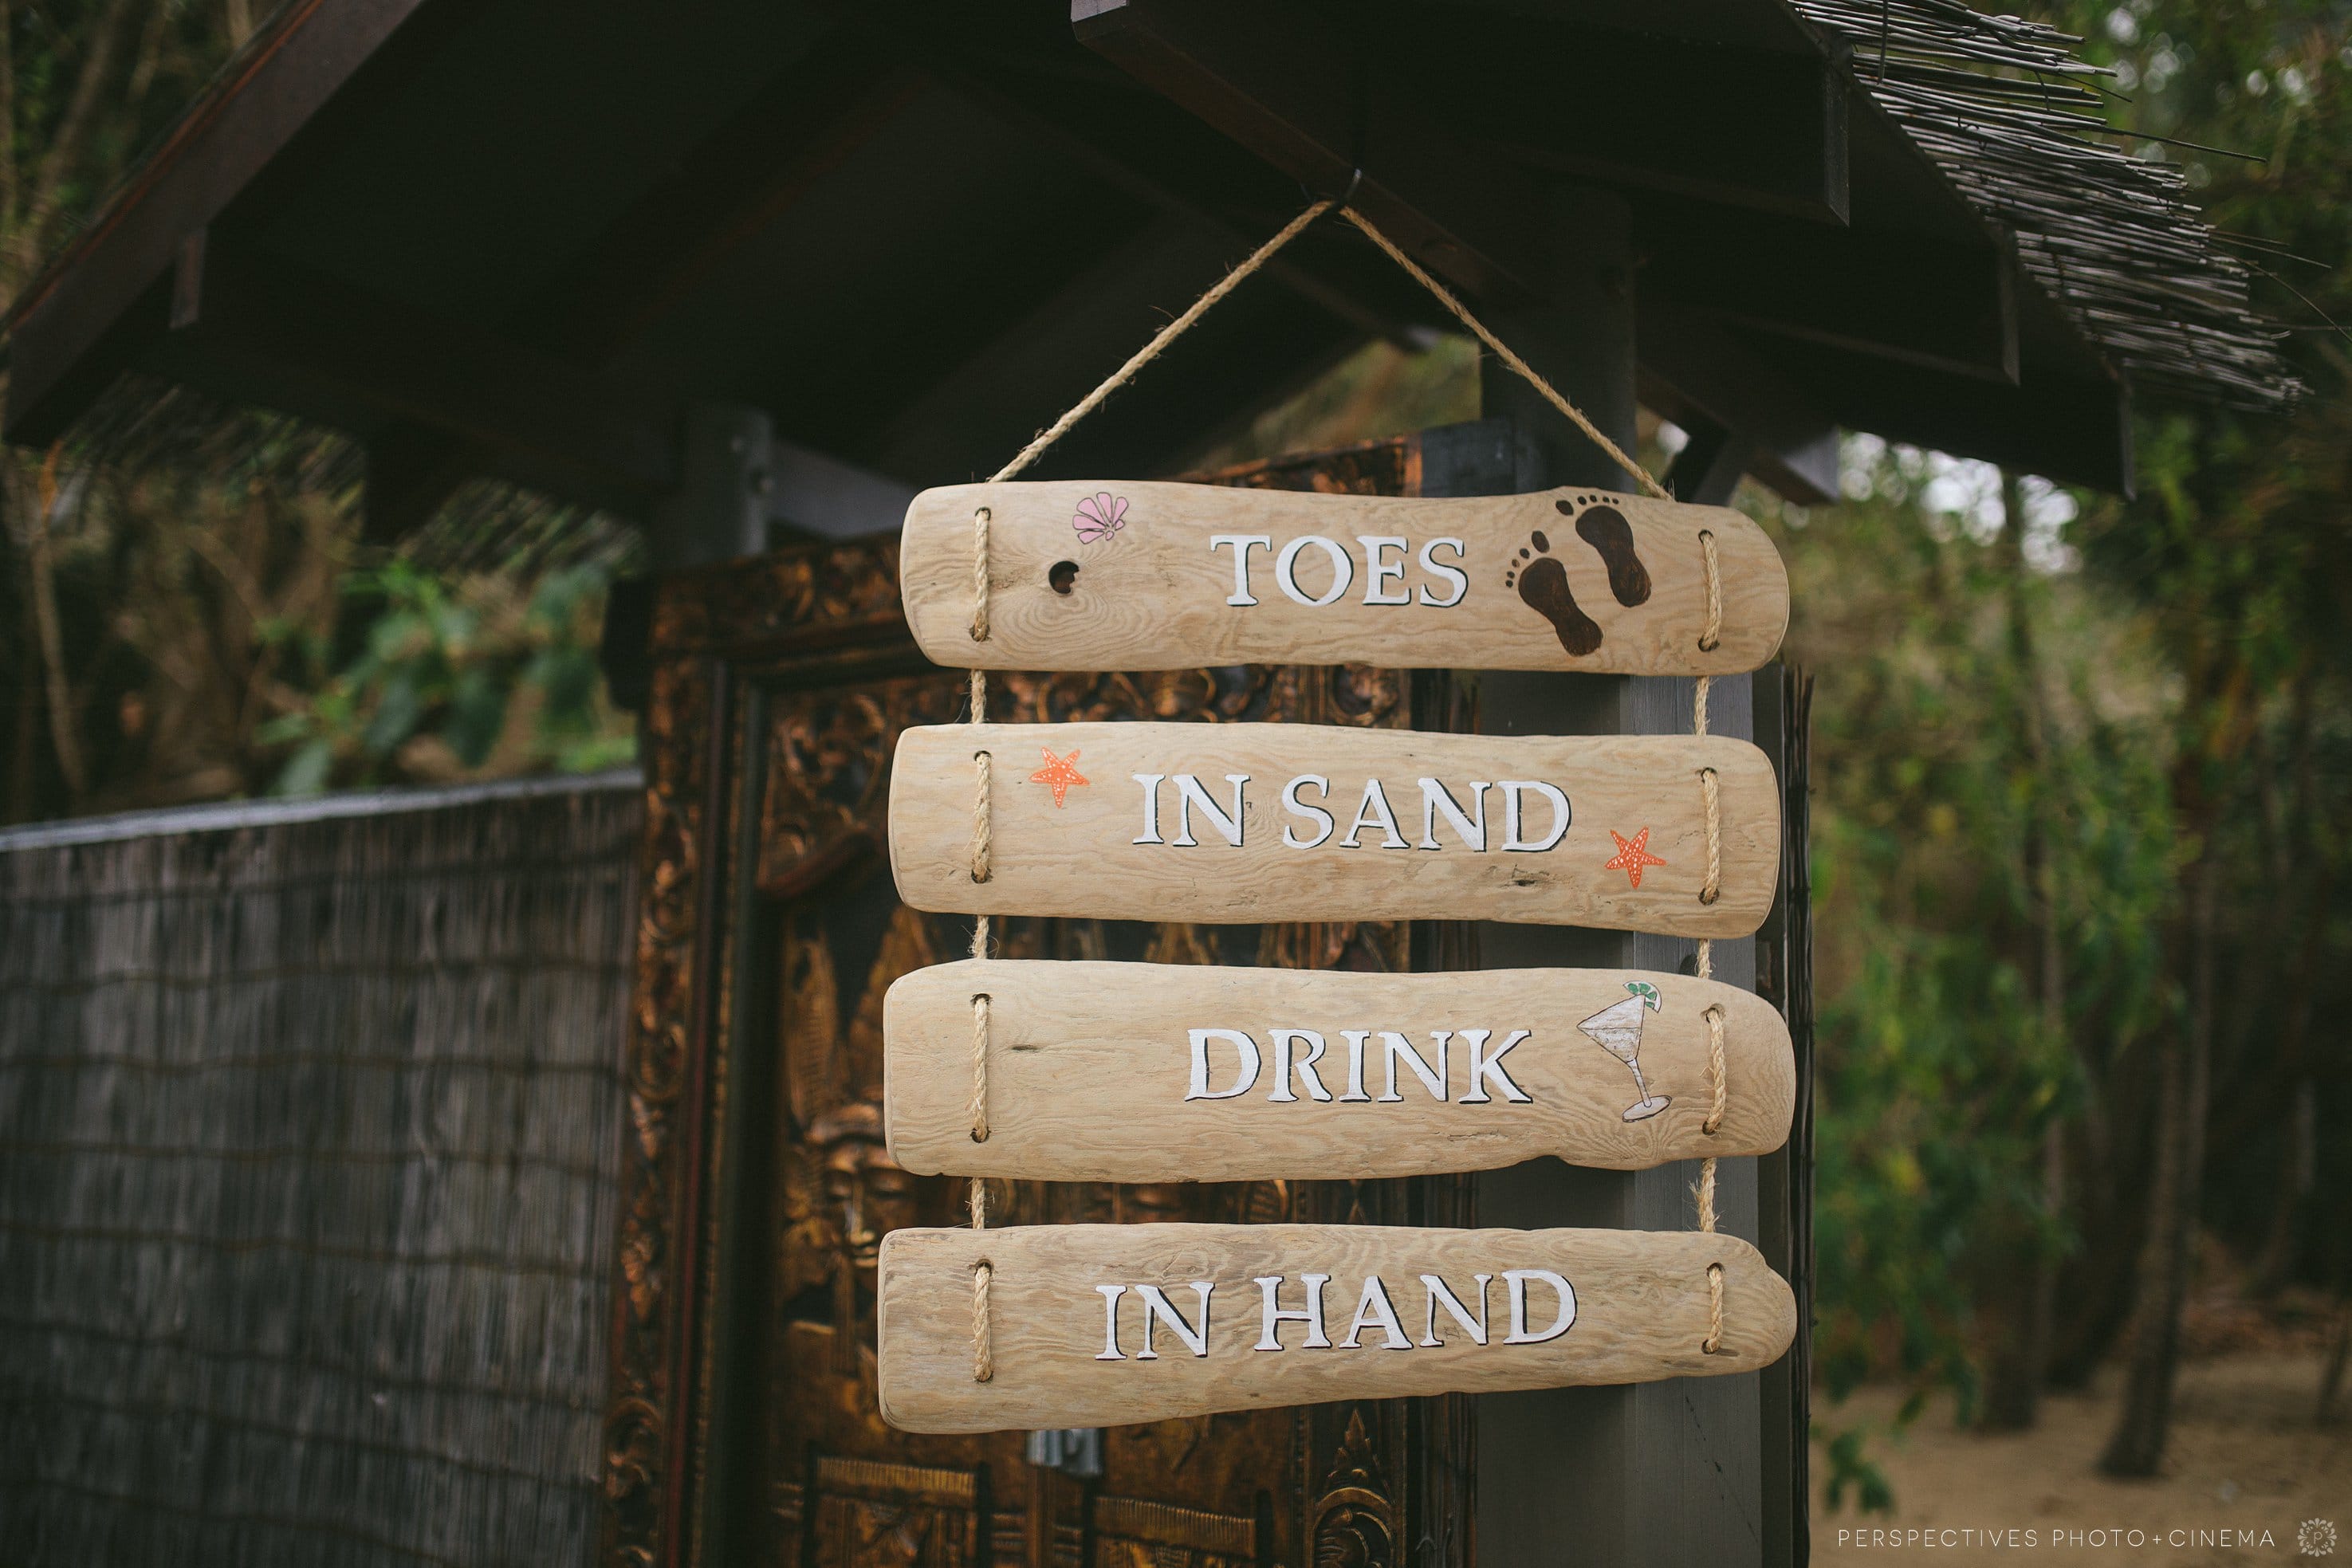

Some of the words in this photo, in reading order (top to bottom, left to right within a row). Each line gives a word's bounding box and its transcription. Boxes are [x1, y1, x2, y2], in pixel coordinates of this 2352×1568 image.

[1210, 535, 1469, 608] TOES
[1132, 772, 1250, 849] IN
[1282, 773, 1572, 852] SAND
[1186, 1028, 1533, 1103] DRINK
[1095, 1280, 1216, 1361] IN
[1252, 1269, 1578, 1353] HAND
